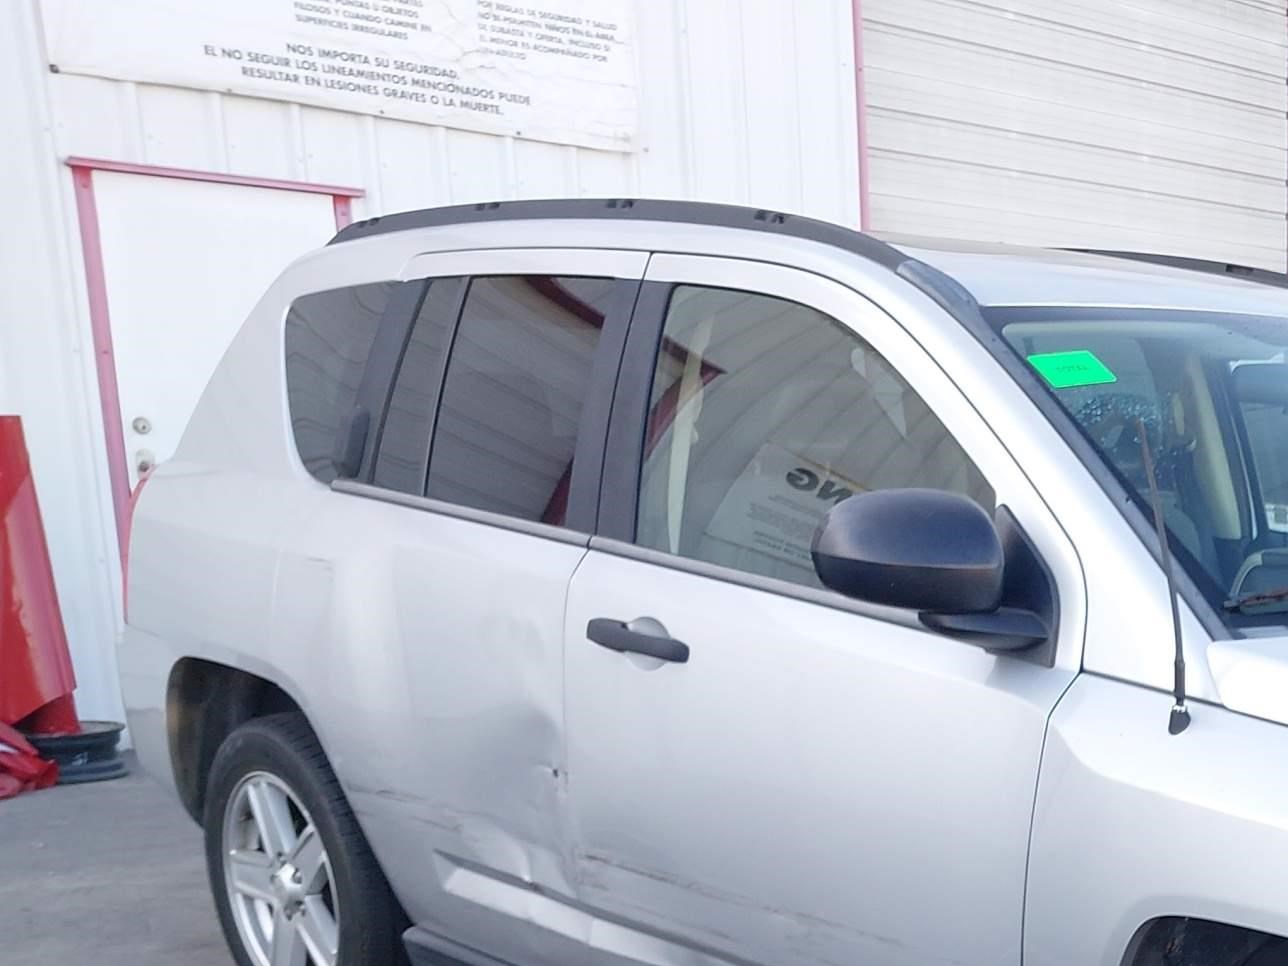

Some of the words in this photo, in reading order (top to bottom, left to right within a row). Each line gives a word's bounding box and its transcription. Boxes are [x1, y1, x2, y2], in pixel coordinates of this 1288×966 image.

[342, 10, 381, 23] CUANDO
[286, 42, 313, 57] NOS
[318, 48, 370, 65] IMPORTA
[375, 57, 390, 68] SU
[204, 44, 218, 57] EL
[221, 48, 242, 61] NO
[247, 51, 291, 67] SEGUIR
[295, 59, 320, 72] LOS
[321, 64, 407, 86] LINEAMIENTOS
[411, 77, 495, 100] MENCIONADOS
[498, 91, 531, 106] PUEDE
[241, 65, 300, 84] RESULTAR
[305, 75, 321, 87] EN
[324, 79, 379, 96] LESIONES
[383, 87, 427, 104] GRAVES
[430, 95, 439, 105] O
[443, 97, 457, 108] LA
